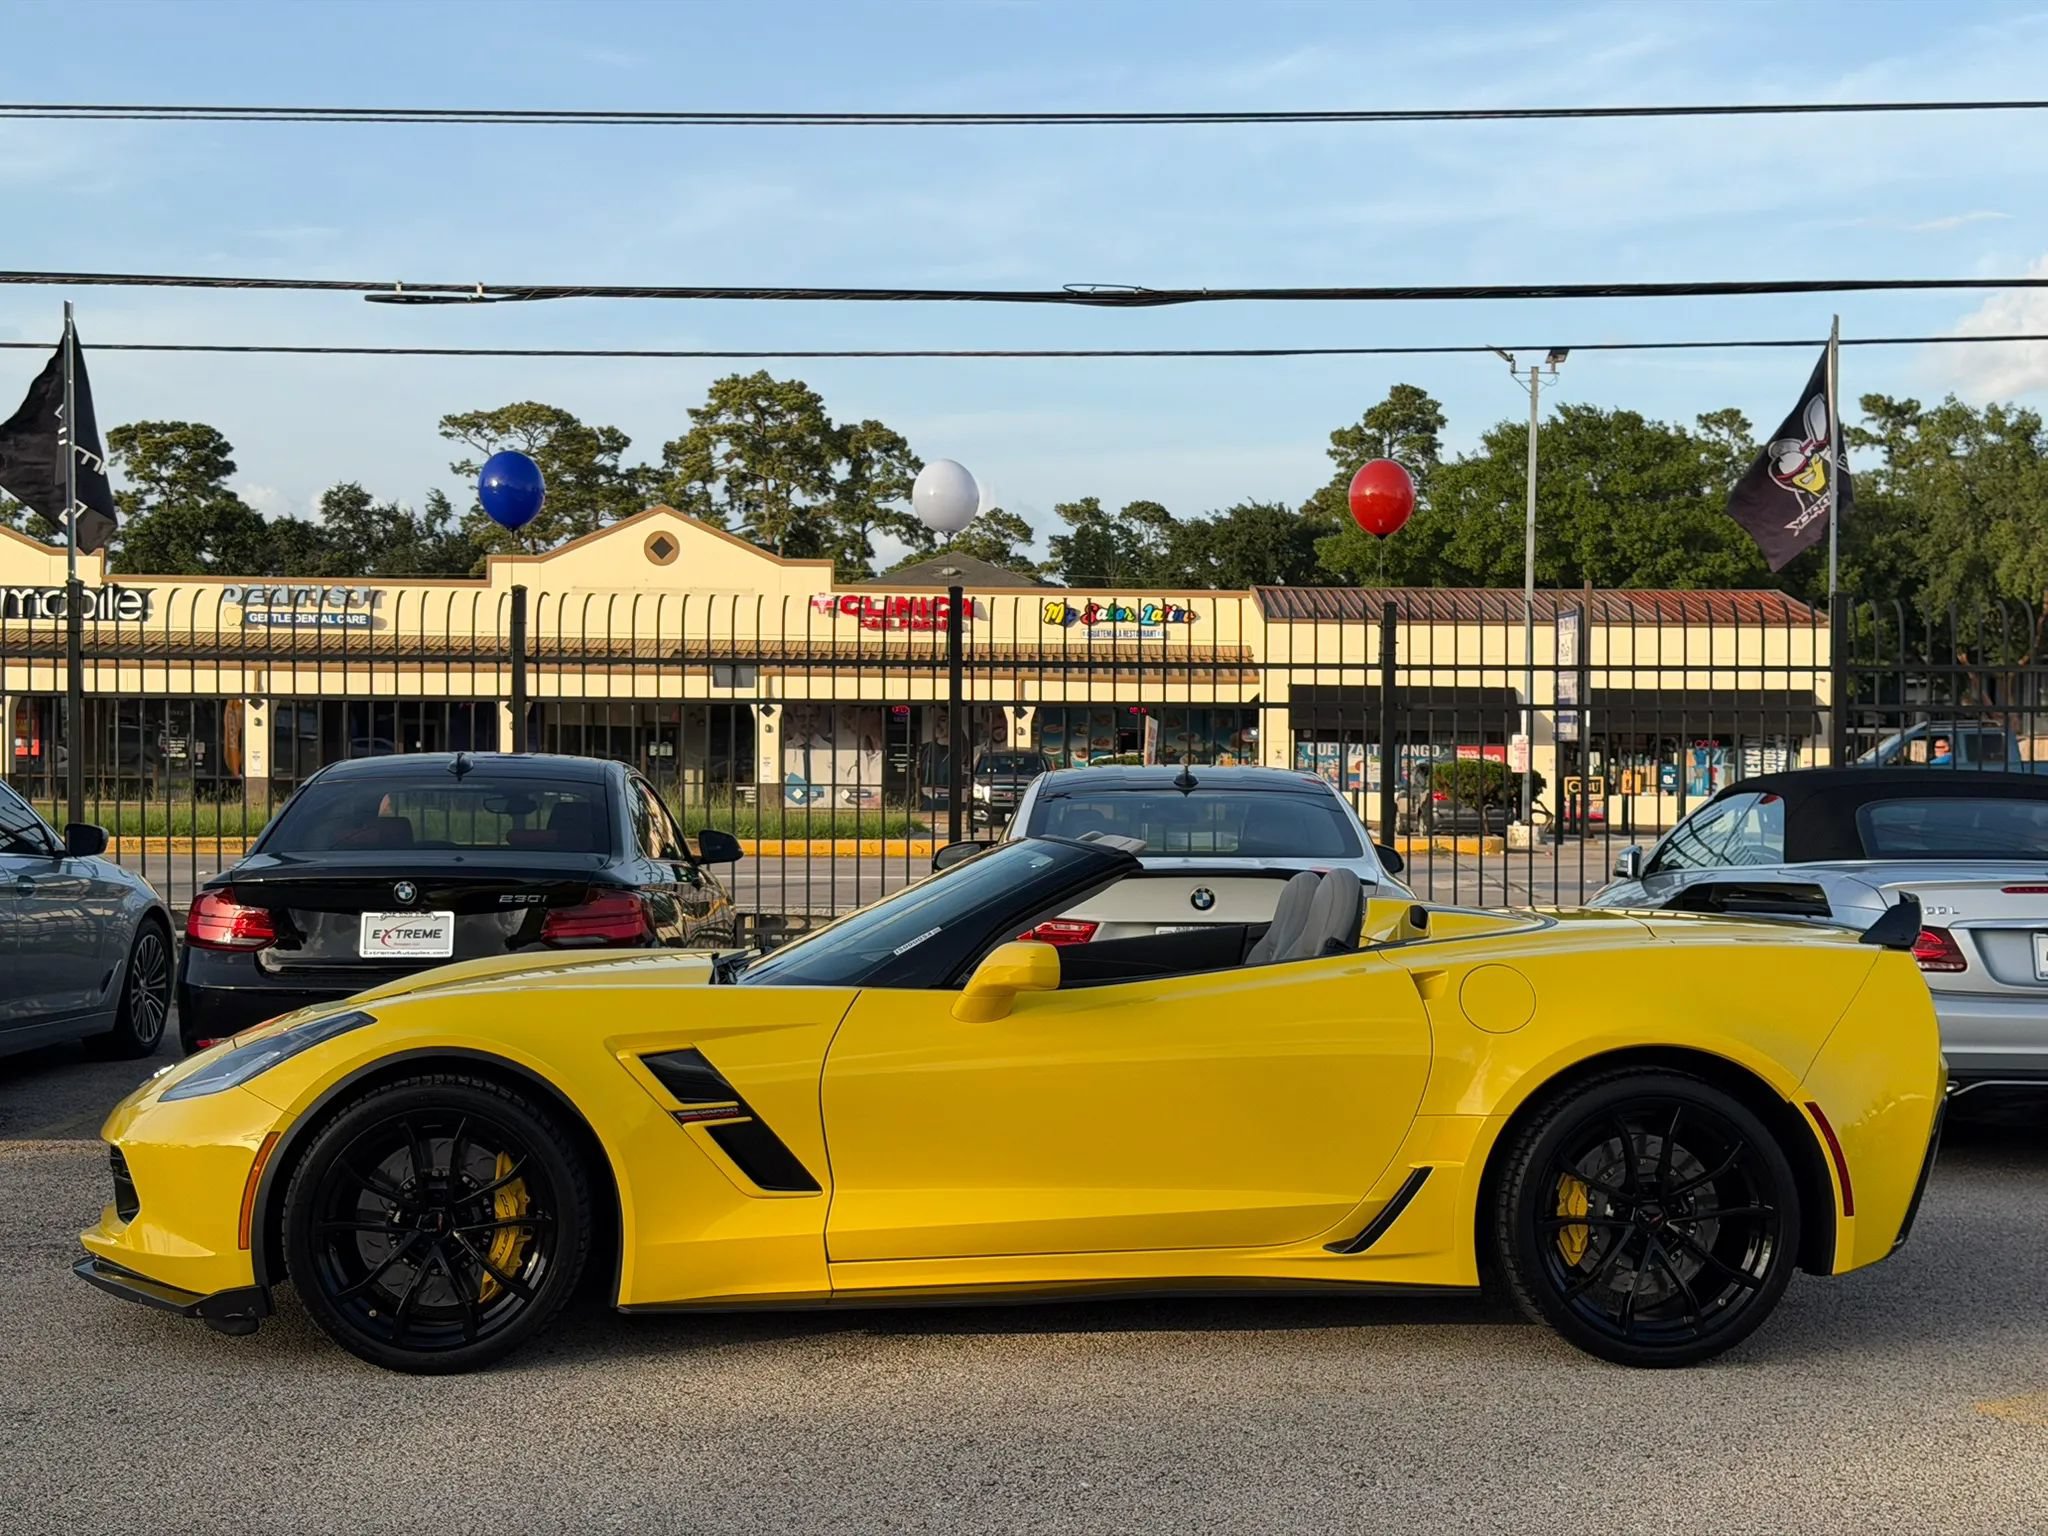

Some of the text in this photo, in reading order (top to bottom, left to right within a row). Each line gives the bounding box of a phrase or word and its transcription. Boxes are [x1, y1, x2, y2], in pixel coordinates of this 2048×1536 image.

[223, 584, 371, 604] DENTIST
[296, 614, 333, 623] DENAL
[337, 615, 367, 624] CARE
[1081, 603, 1136, 625] Sabor
[1140, 604, 1197, 625] Latino
[1307, 743, 1441, 757] QUETZALTANGO
[372, 928, 443, 940] EXTREME
